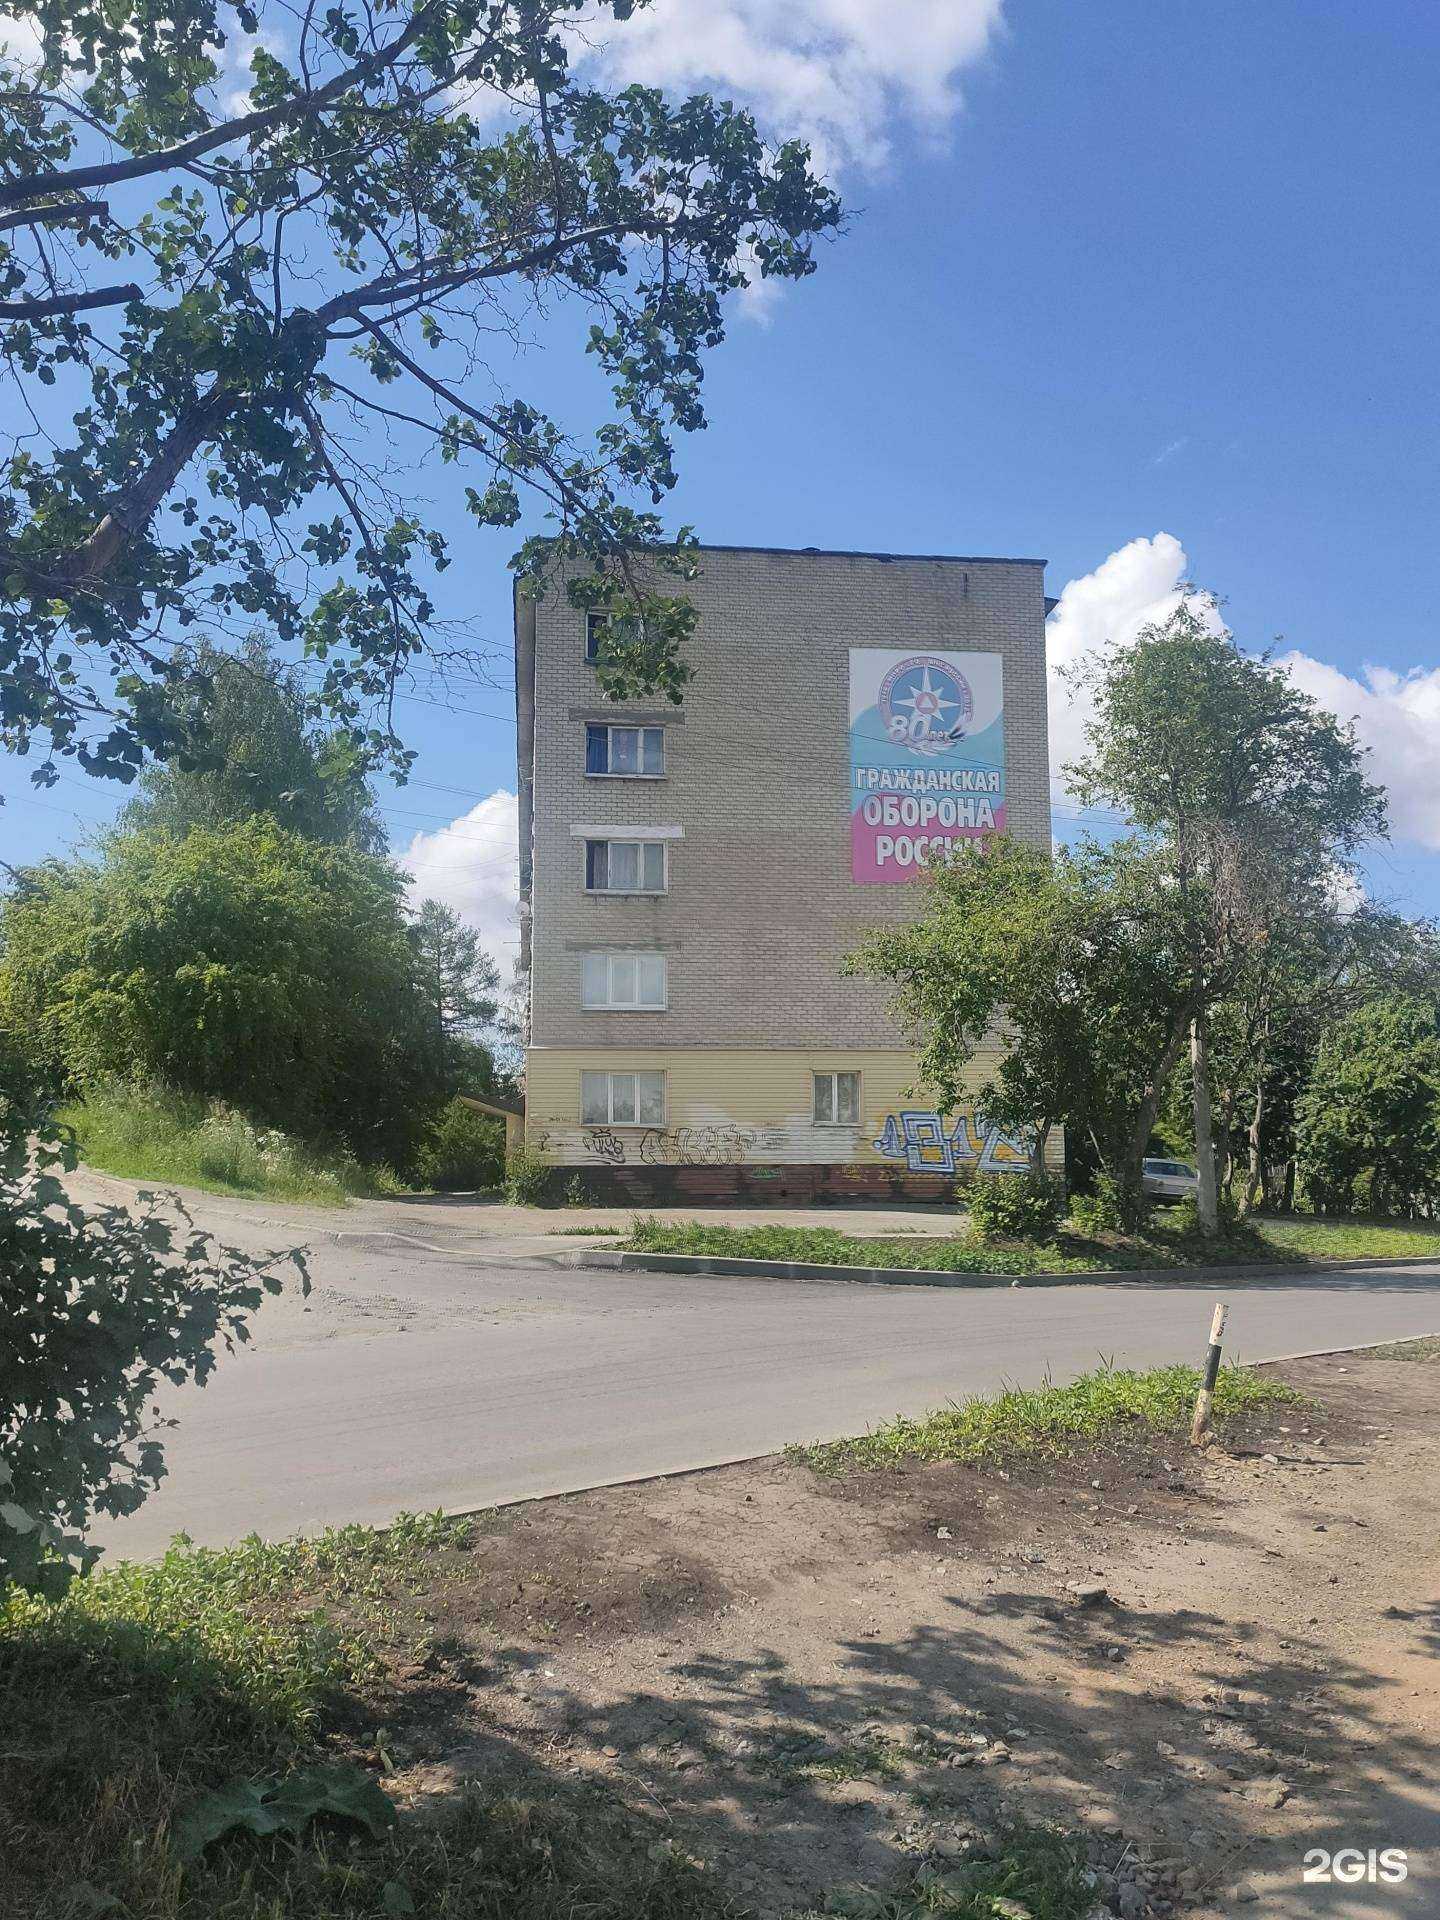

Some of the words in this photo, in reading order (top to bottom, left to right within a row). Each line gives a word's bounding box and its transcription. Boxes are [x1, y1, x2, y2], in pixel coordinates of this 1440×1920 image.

[889, 714, 931, 741] 80
[856, 767, 1001, 794] ГРАЖДАНСКАЯ
[863, 794, 996, 829] ОБОРОНА
